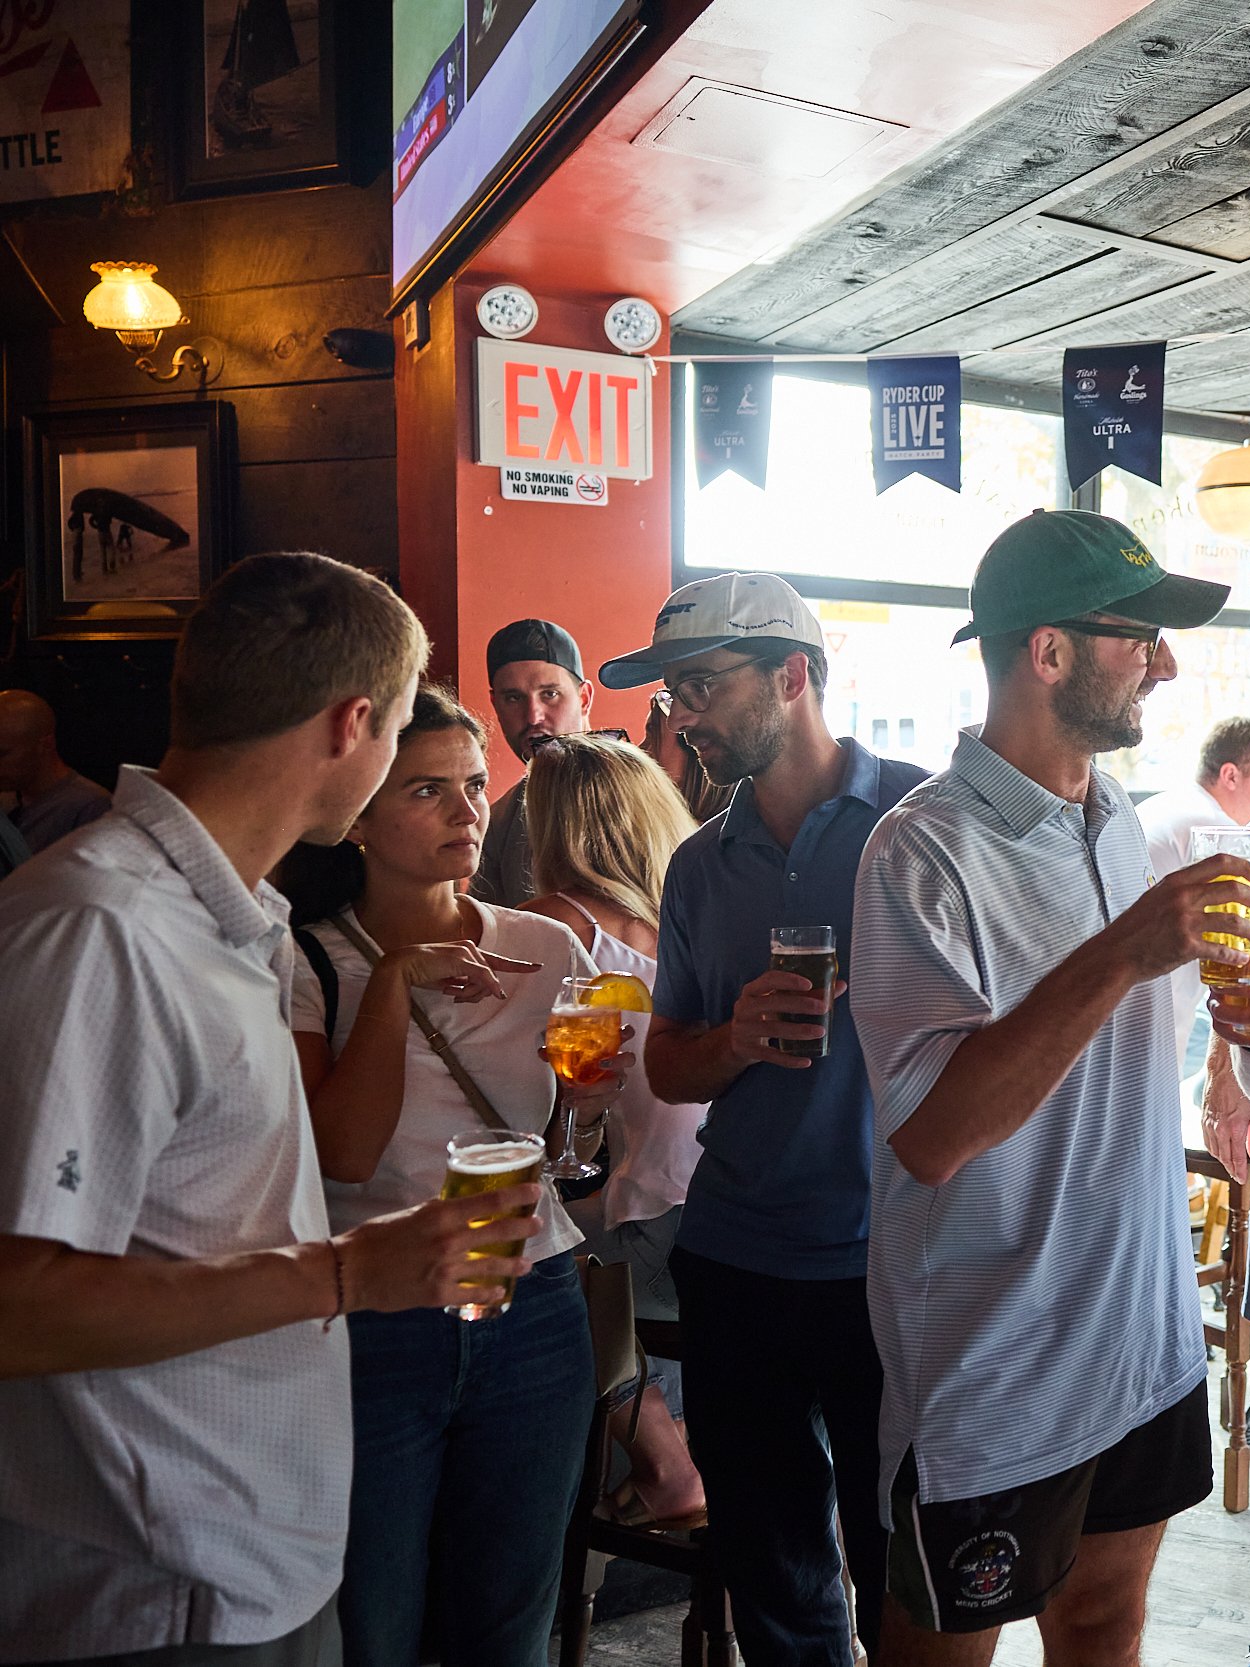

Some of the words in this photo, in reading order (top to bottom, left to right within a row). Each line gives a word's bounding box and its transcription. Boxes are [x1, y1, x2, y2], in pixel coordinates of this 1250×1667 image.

[0, 129, 62, 170] TTLE
[1076, 368, 1098, 378] Tito's
[882, 386, 920, 404] RYDER
[922, 385, 945, 402] CUP
[504, 361, 638, 468] EXIT
[883, 404, 945, 448] LIVE
[1092, 423, 1132, 435] ULTRA
[714, 437, 745, 446] ULTRA
[506, 470, 521, 482] NO
[525, 472, 574, 485] SMOKING
[512, 483, 527, 494] NO
[531, 485, 569, 497] VAPING
